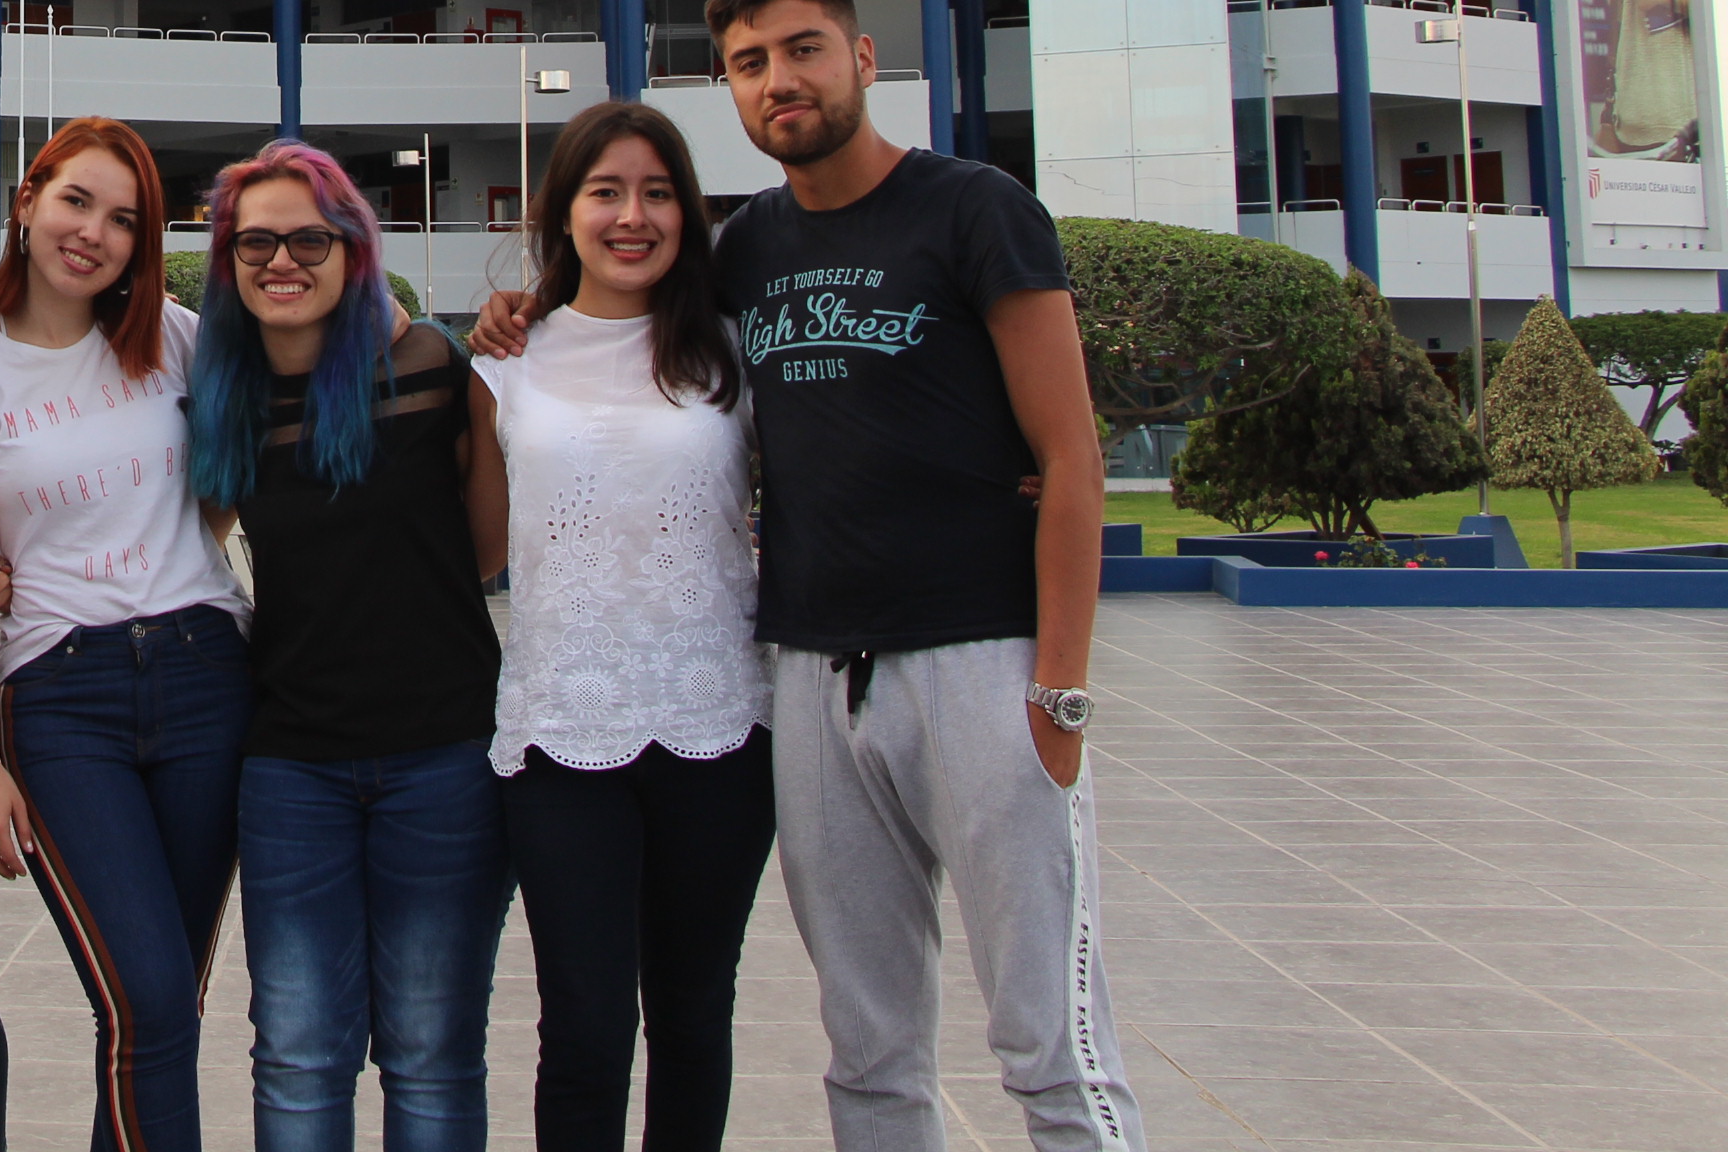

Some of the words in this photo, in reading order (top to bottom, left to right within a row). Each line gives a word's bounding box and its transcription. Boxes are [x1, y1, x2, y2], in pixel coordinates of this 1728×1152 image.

[1603, 179, 1647, 192] UNIVERSIDAD
[1669, 183, 1697, 195] VALLEJO
[766, 276, 790, 298] LET
[793, 268, 864, 290] YOURSELF
[864, 269, 884, 288] GO
[738, 304, 796, 365] High
[805, 292, 940, 345] Street
[783, 358, 848, 382] GENIUS
[3, 395, 81, 439] MAMA
[101, 369, 164, 409] SAID
[84, 543, 149, 582] DAYS
[1088, 1083, 1119, 1139] ASTER
